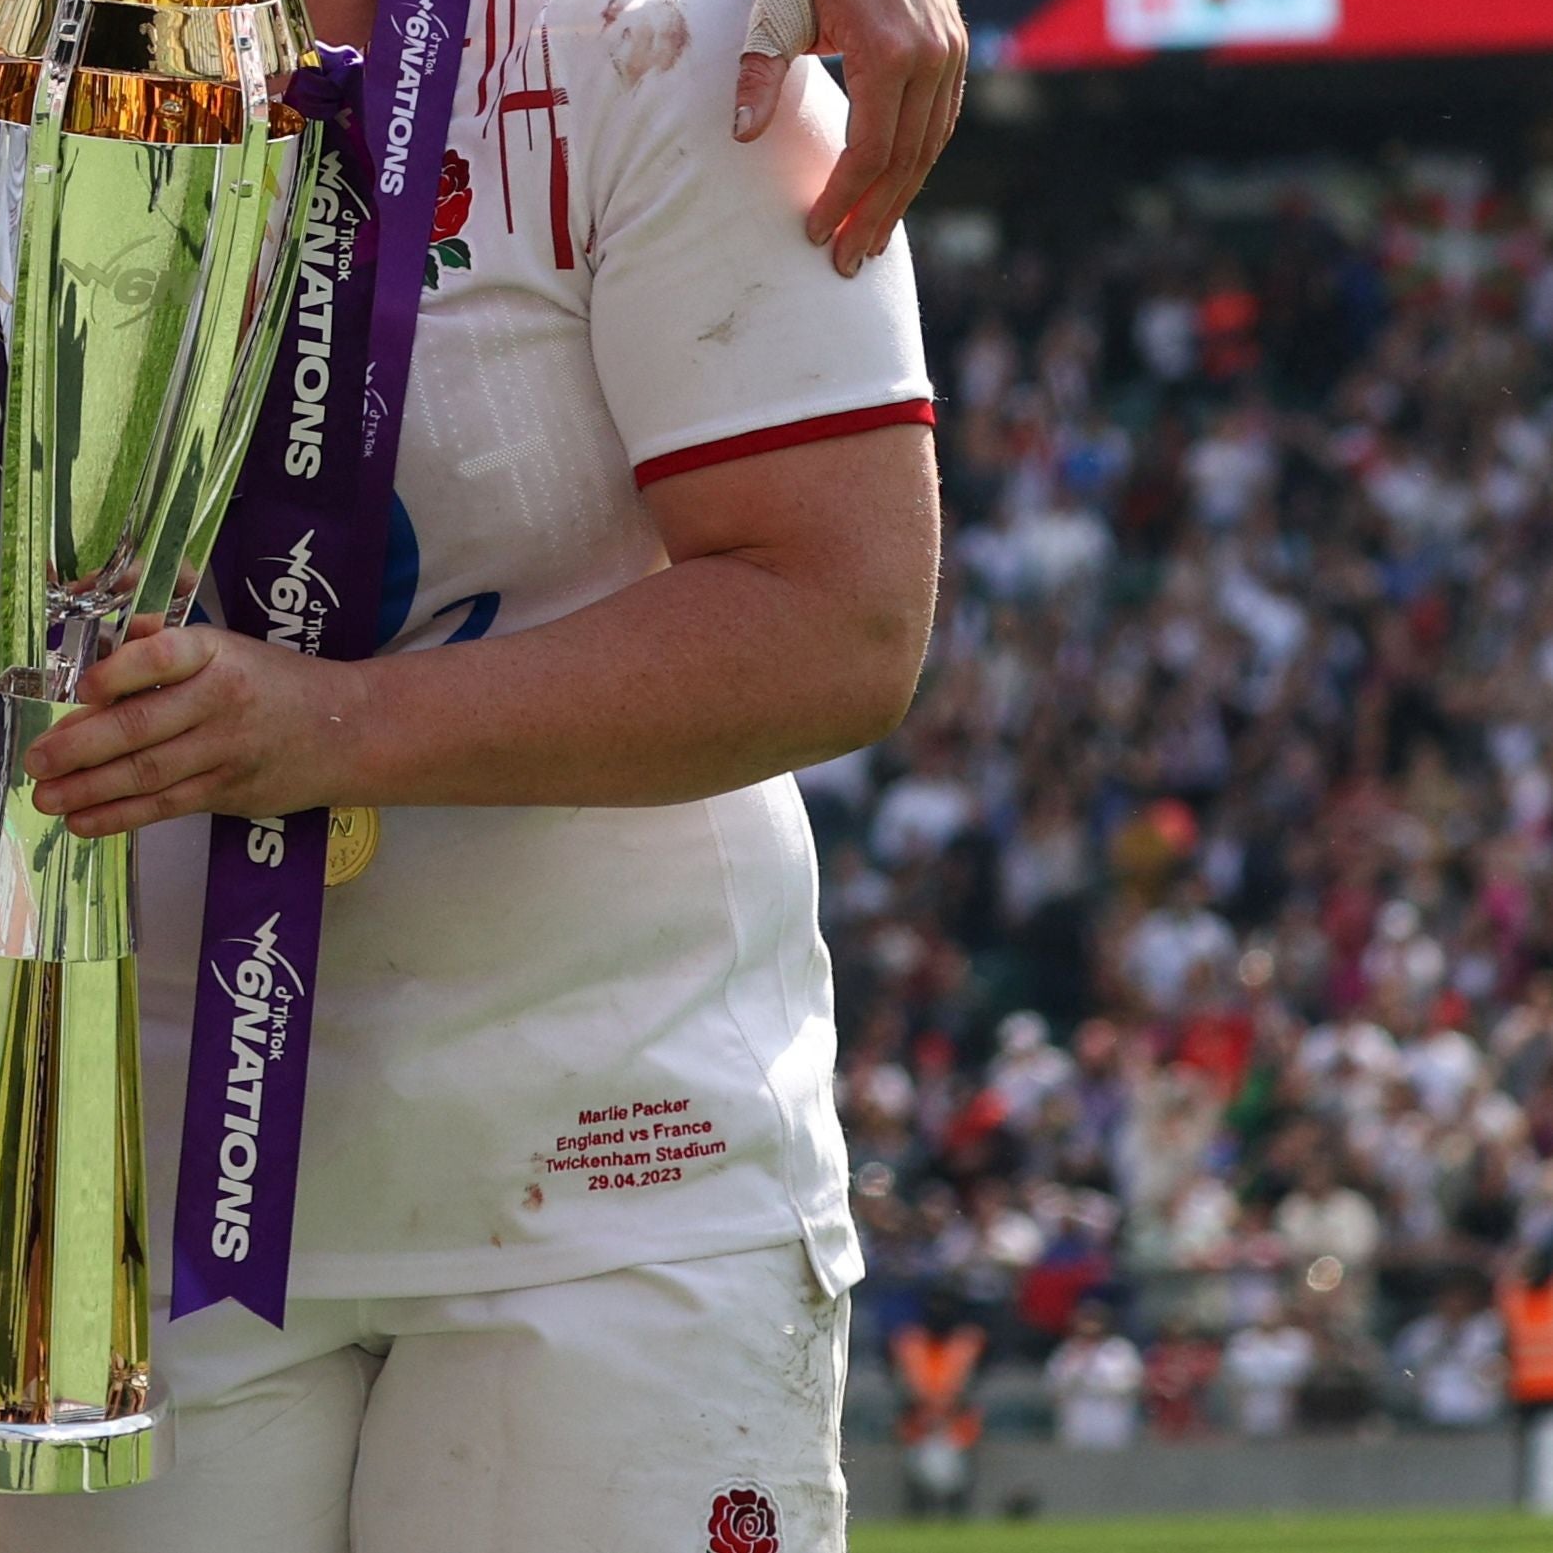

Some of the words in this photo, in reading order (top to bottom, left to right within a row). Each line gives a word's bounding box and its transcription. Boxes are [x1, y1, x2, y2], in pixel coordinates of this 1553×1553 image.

[379, 15, 431, 198] 6NATIONS
[337, 227, 357, 284] TikTok
[284, 186, 342, 480] 6NATIONS
[268, 1004, 288, 1062] TikTok
[211, 958, 274, 1263] 6NATIONS
[556, 1128, 624, 1152] England
[629, 1129, 649, 1142] vs
[653, 1120, 713, 1140] France
[578, 1106, 628, 1126] Marlie
[632, 1098, 691, 1119] Packer
[545, 1151, 651, 1174] Twickenham
[656, 1140, 727, 1161] Stadium
[588, 1167, 683, 1191] 29.04.2023
